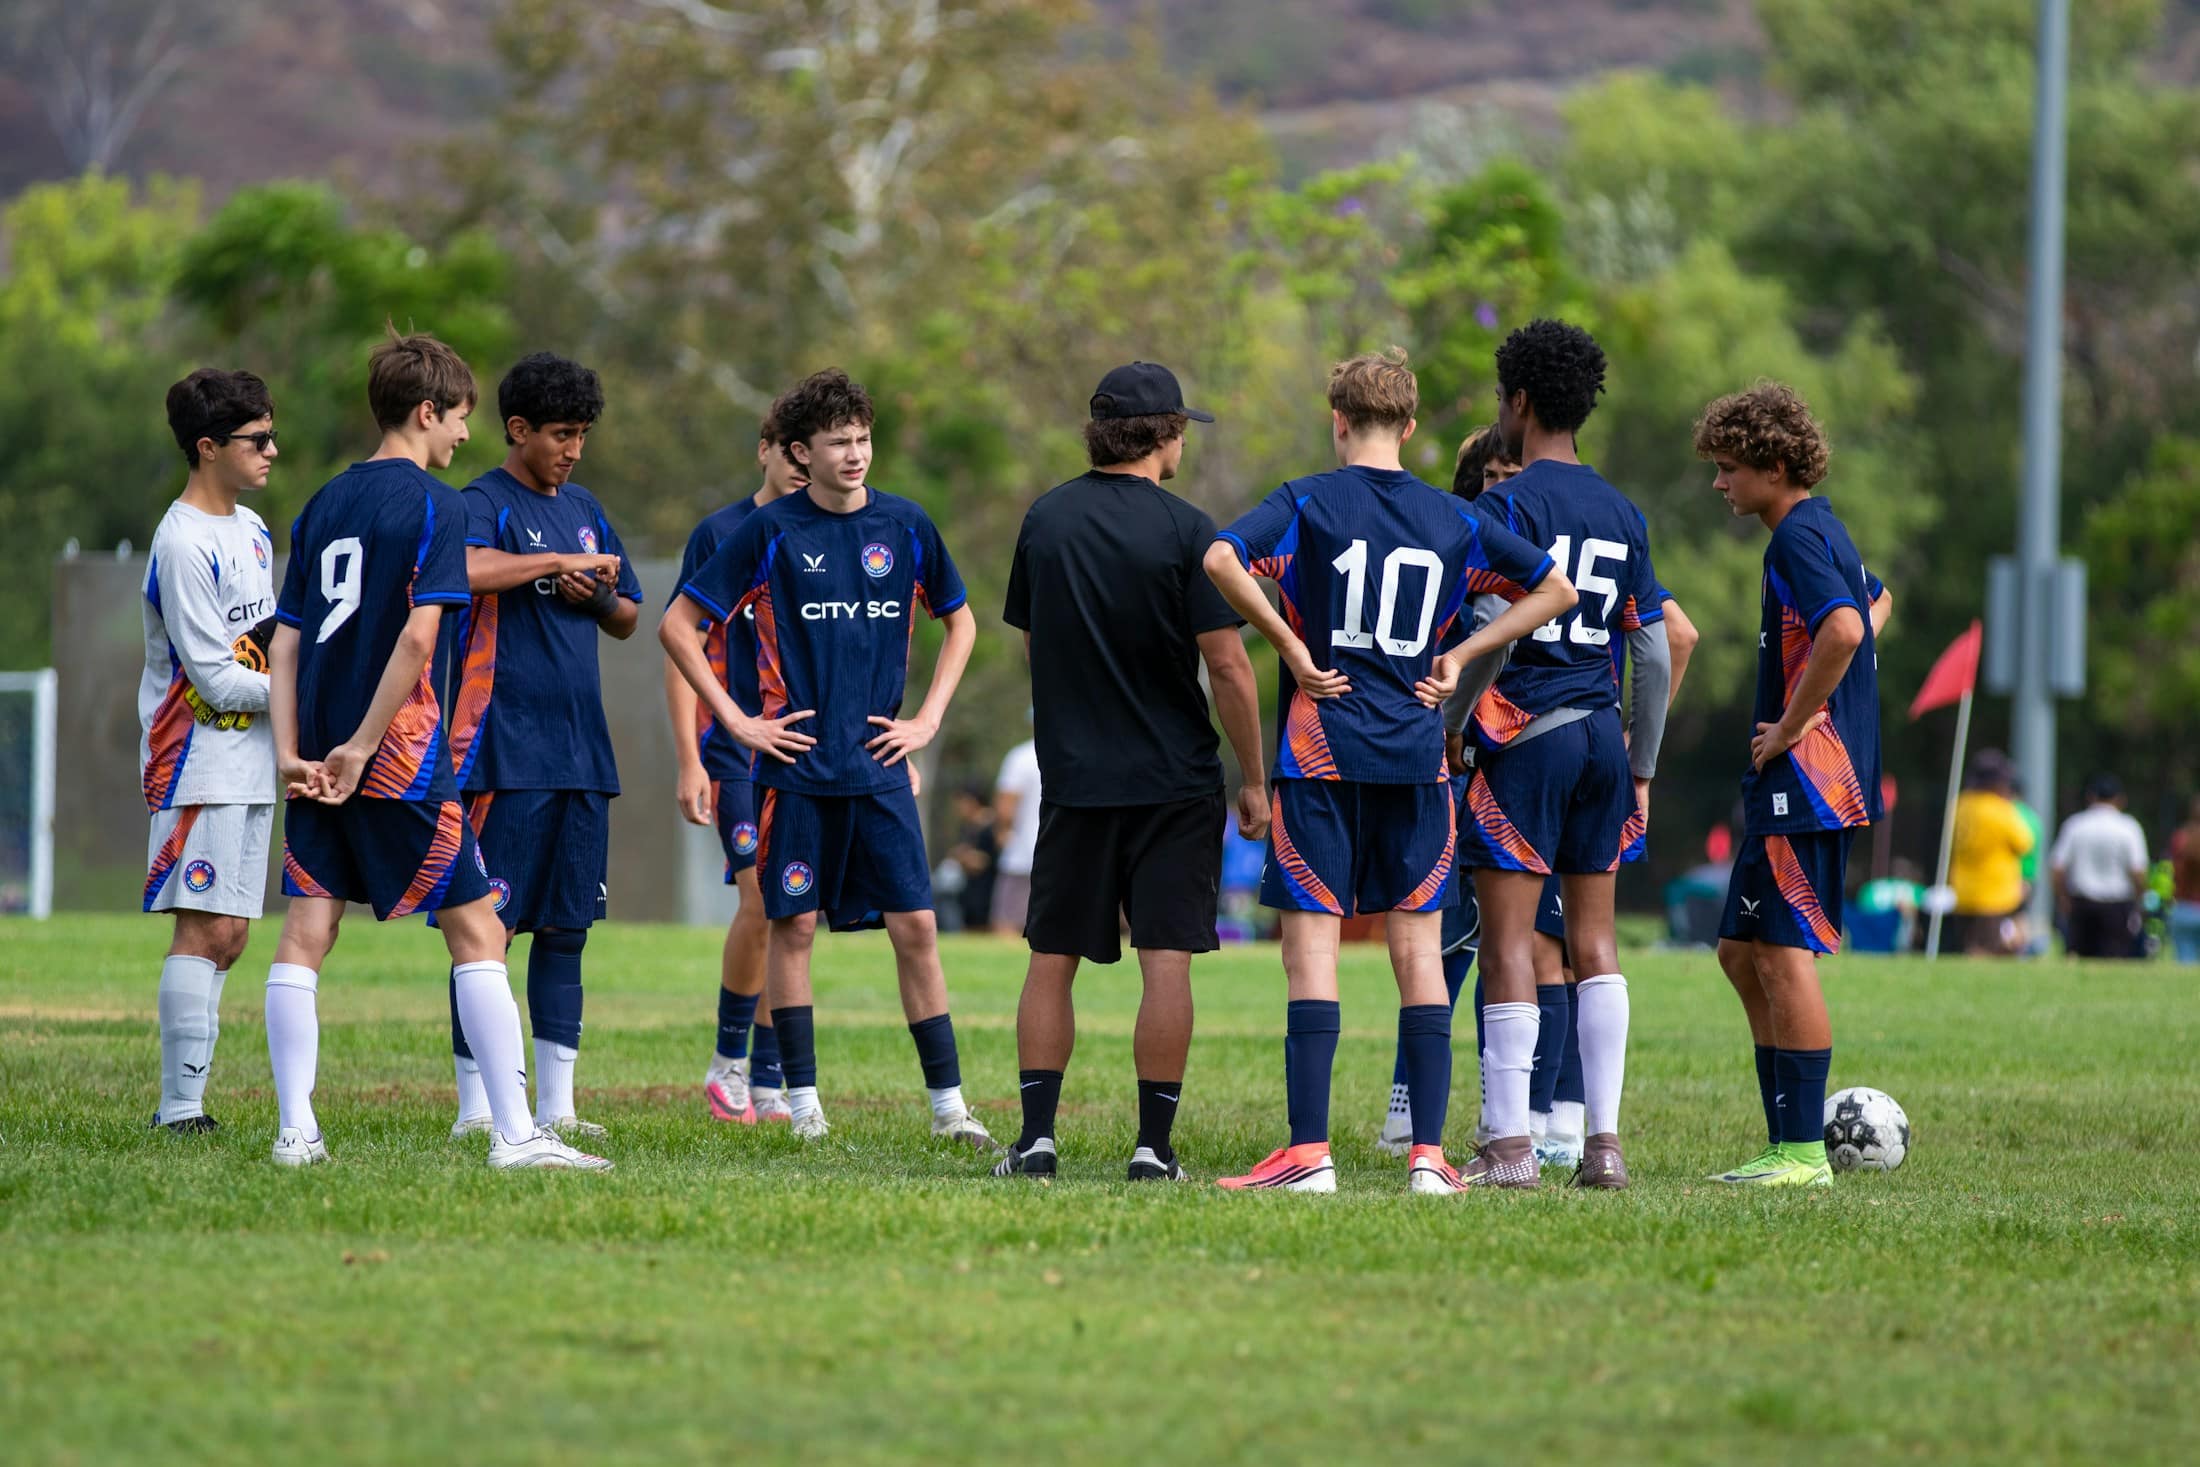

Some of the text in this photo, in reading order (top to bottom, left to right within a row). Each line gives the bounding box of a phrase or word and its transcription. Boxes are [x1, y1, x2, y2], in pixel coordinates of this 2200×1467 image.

[316, 536, 363, 643] 9
[801, 600, 900, 620] CITY SC
[1332, 538, 1444, 658] 10
[1531, 535, 1629, 646] 15
